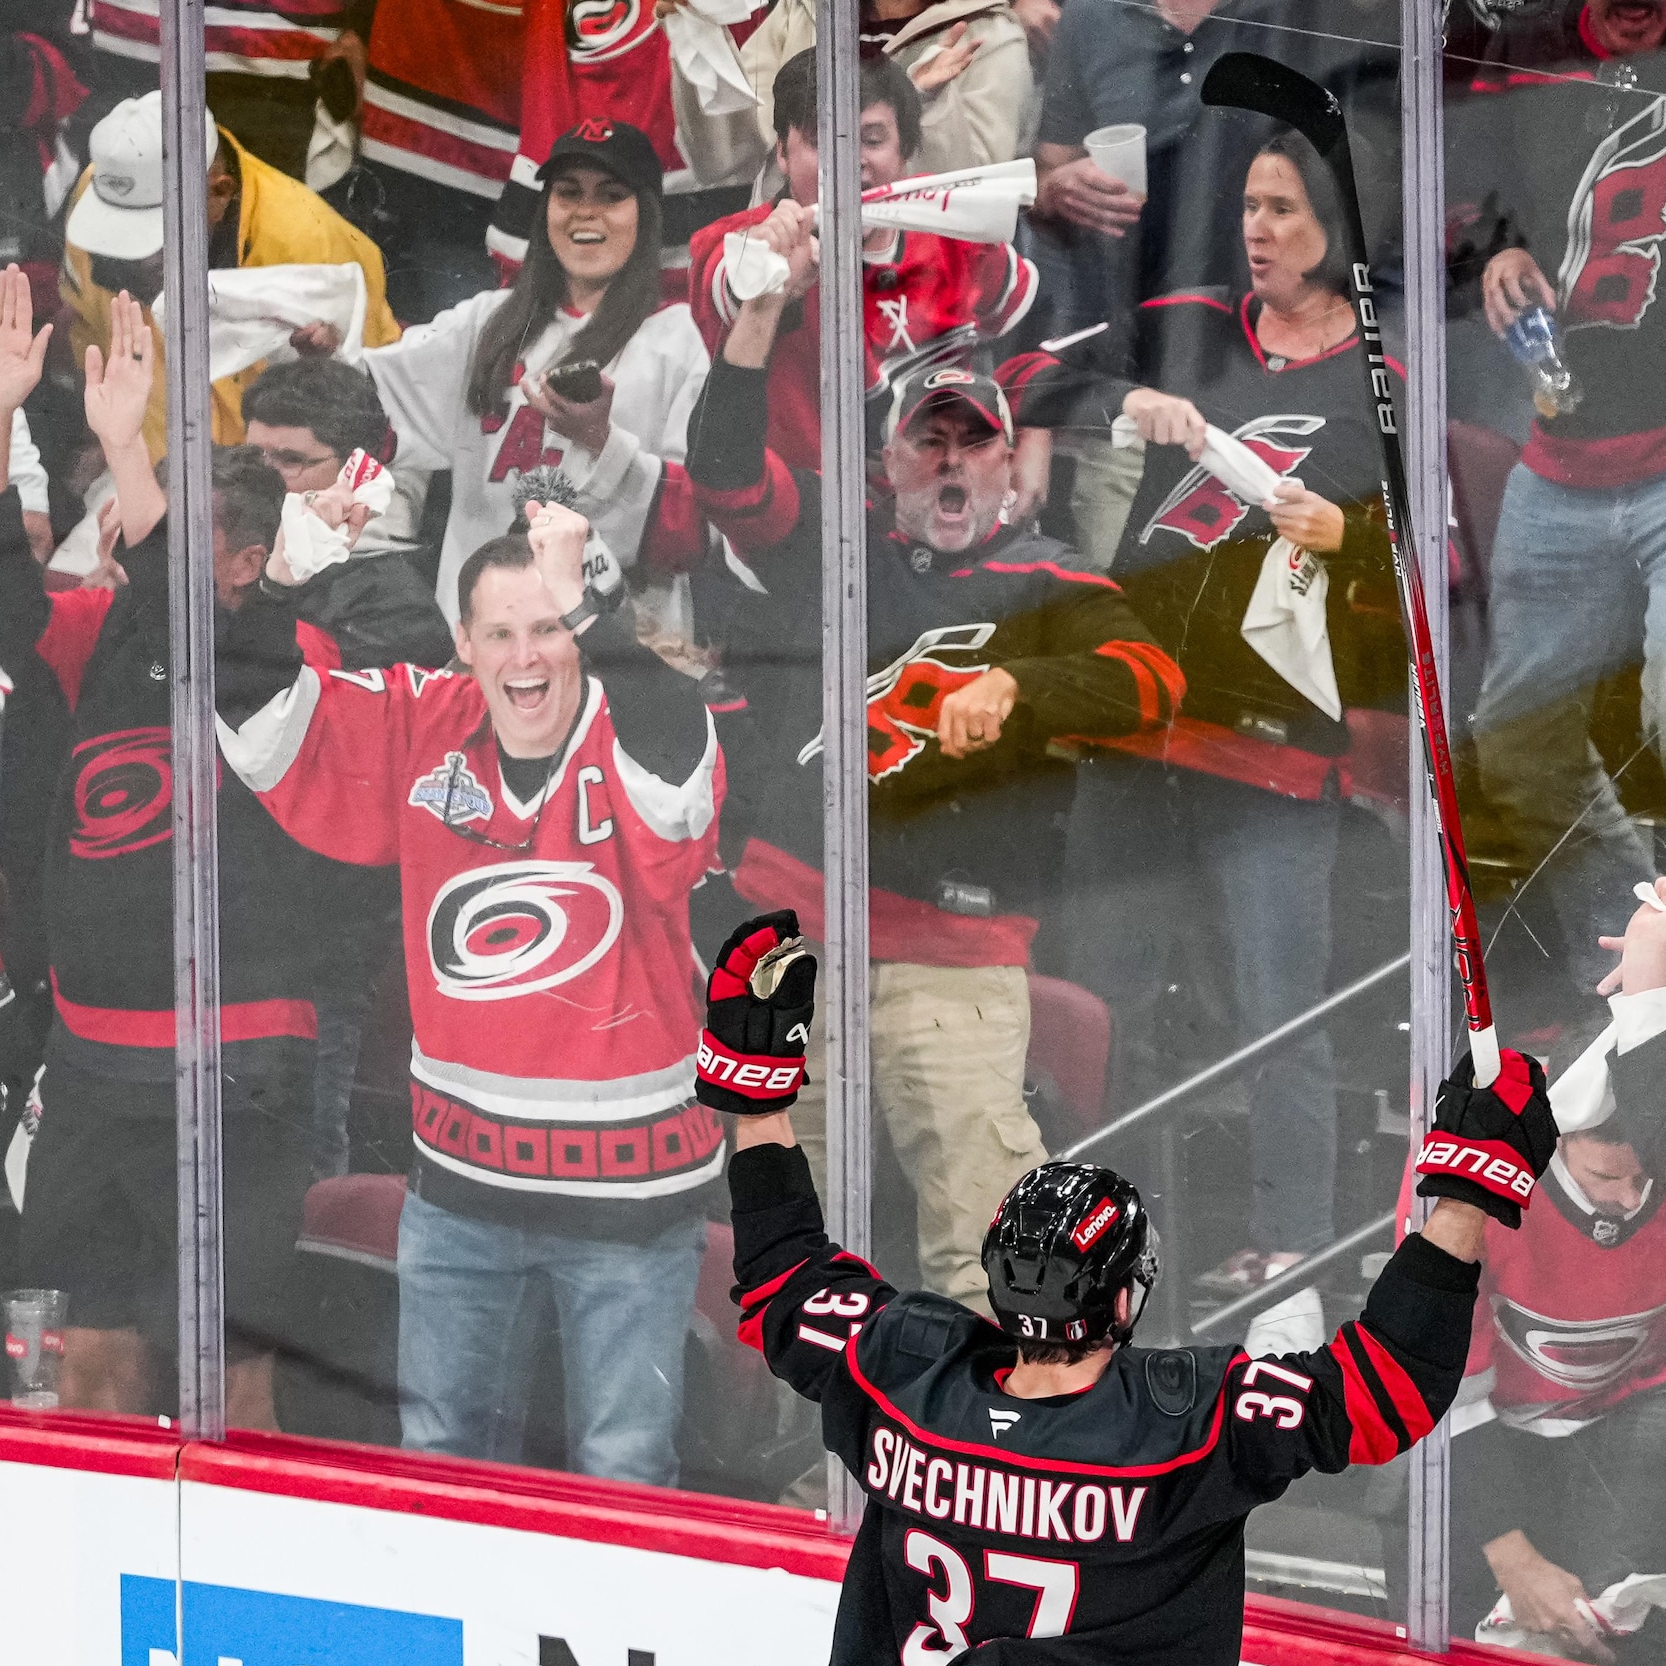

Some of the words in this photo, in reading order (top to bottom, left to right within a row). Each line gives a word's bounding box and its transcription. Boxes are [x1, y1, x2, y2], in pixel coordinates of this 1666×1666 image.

[577, 764, 615, 845] C
[696, 1039, 801, 1090] BAUE
[1076, 1203, 1118, 1246] Lenovo
[1017, 1312, 1049, 1340] 37
[1233, 1360, 1317, 1432] 37
[867, 1425, 1149, 1544] SVECHNIKOV
